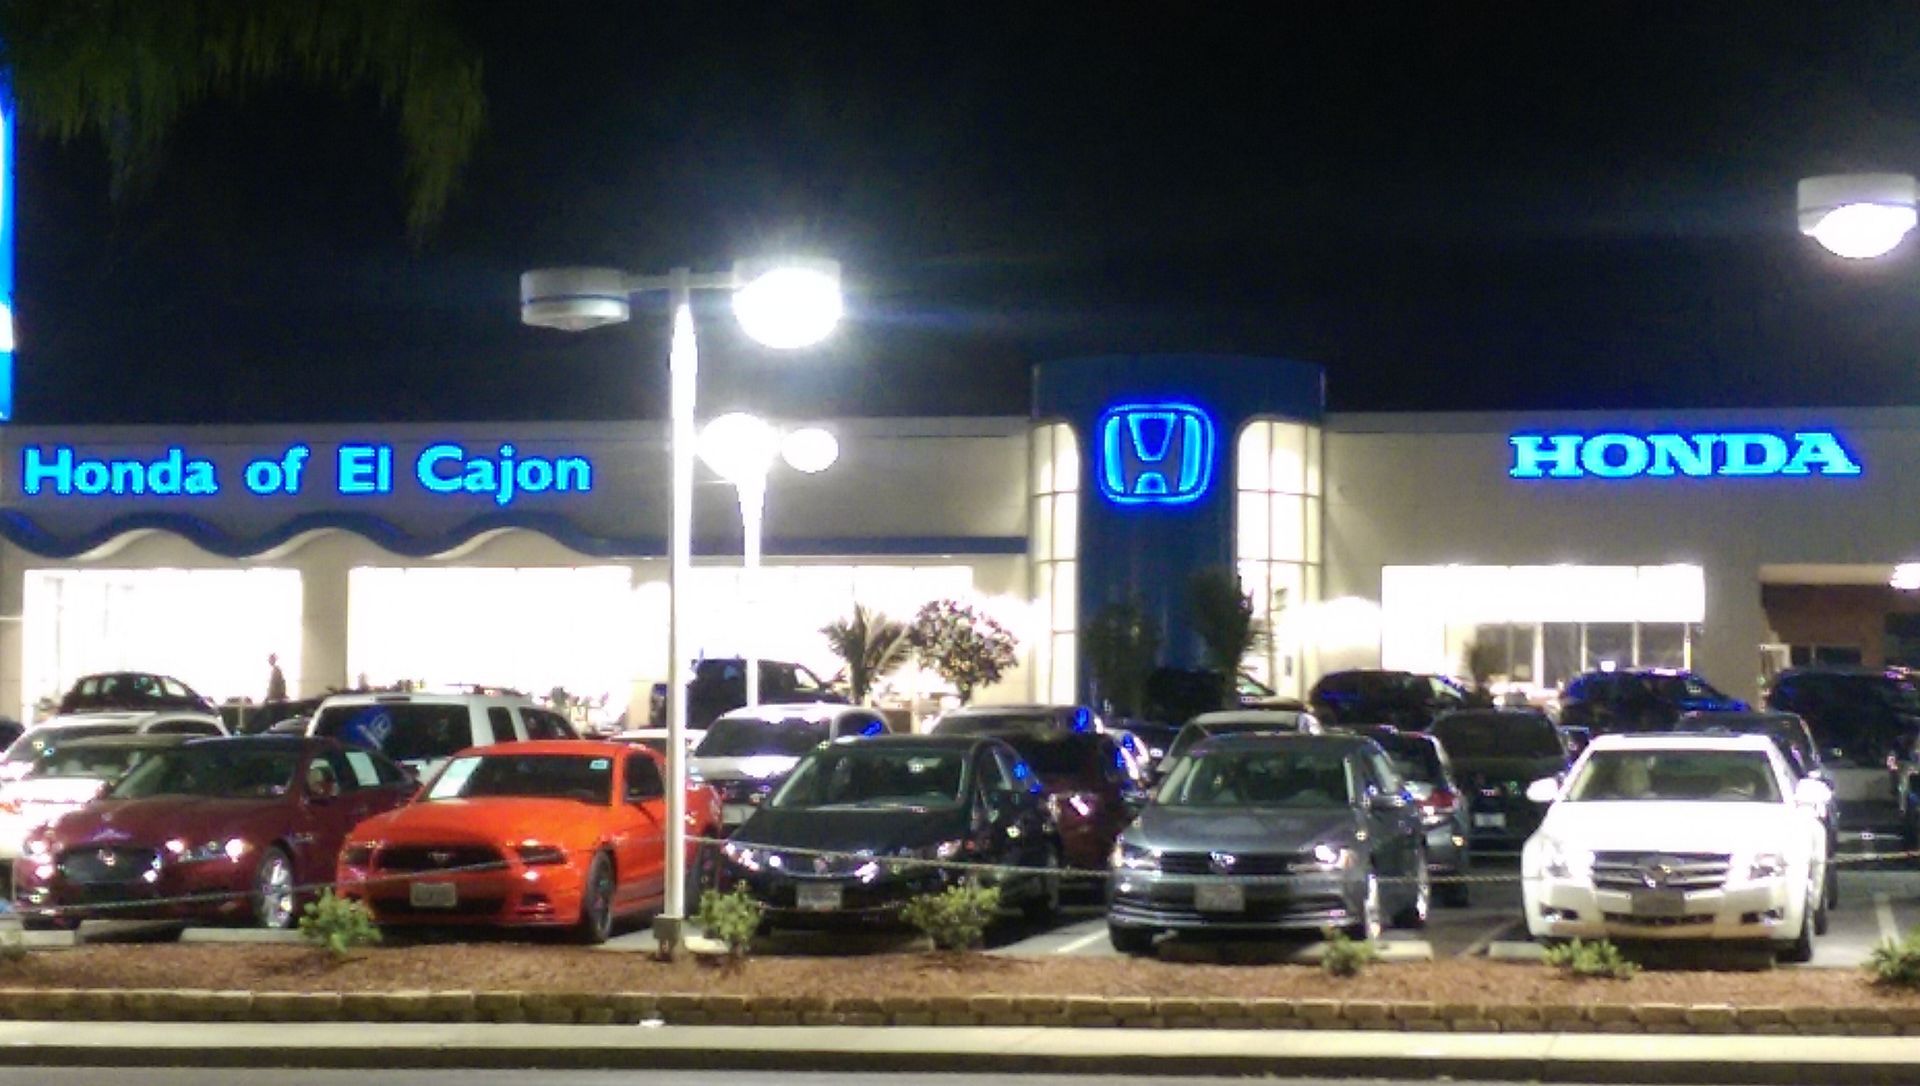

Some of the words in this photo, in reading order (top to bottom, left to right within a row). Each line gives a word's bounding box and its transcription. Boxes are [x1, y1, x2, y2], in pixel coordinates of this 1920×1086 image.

[24, 446, 218, 495] Honda
[244, 445, 309, 495] of
[338, 446, 392, 494] El
[417, 444, 592, 506] Cajon
[1509, 431, 1862, 479] HONDA
